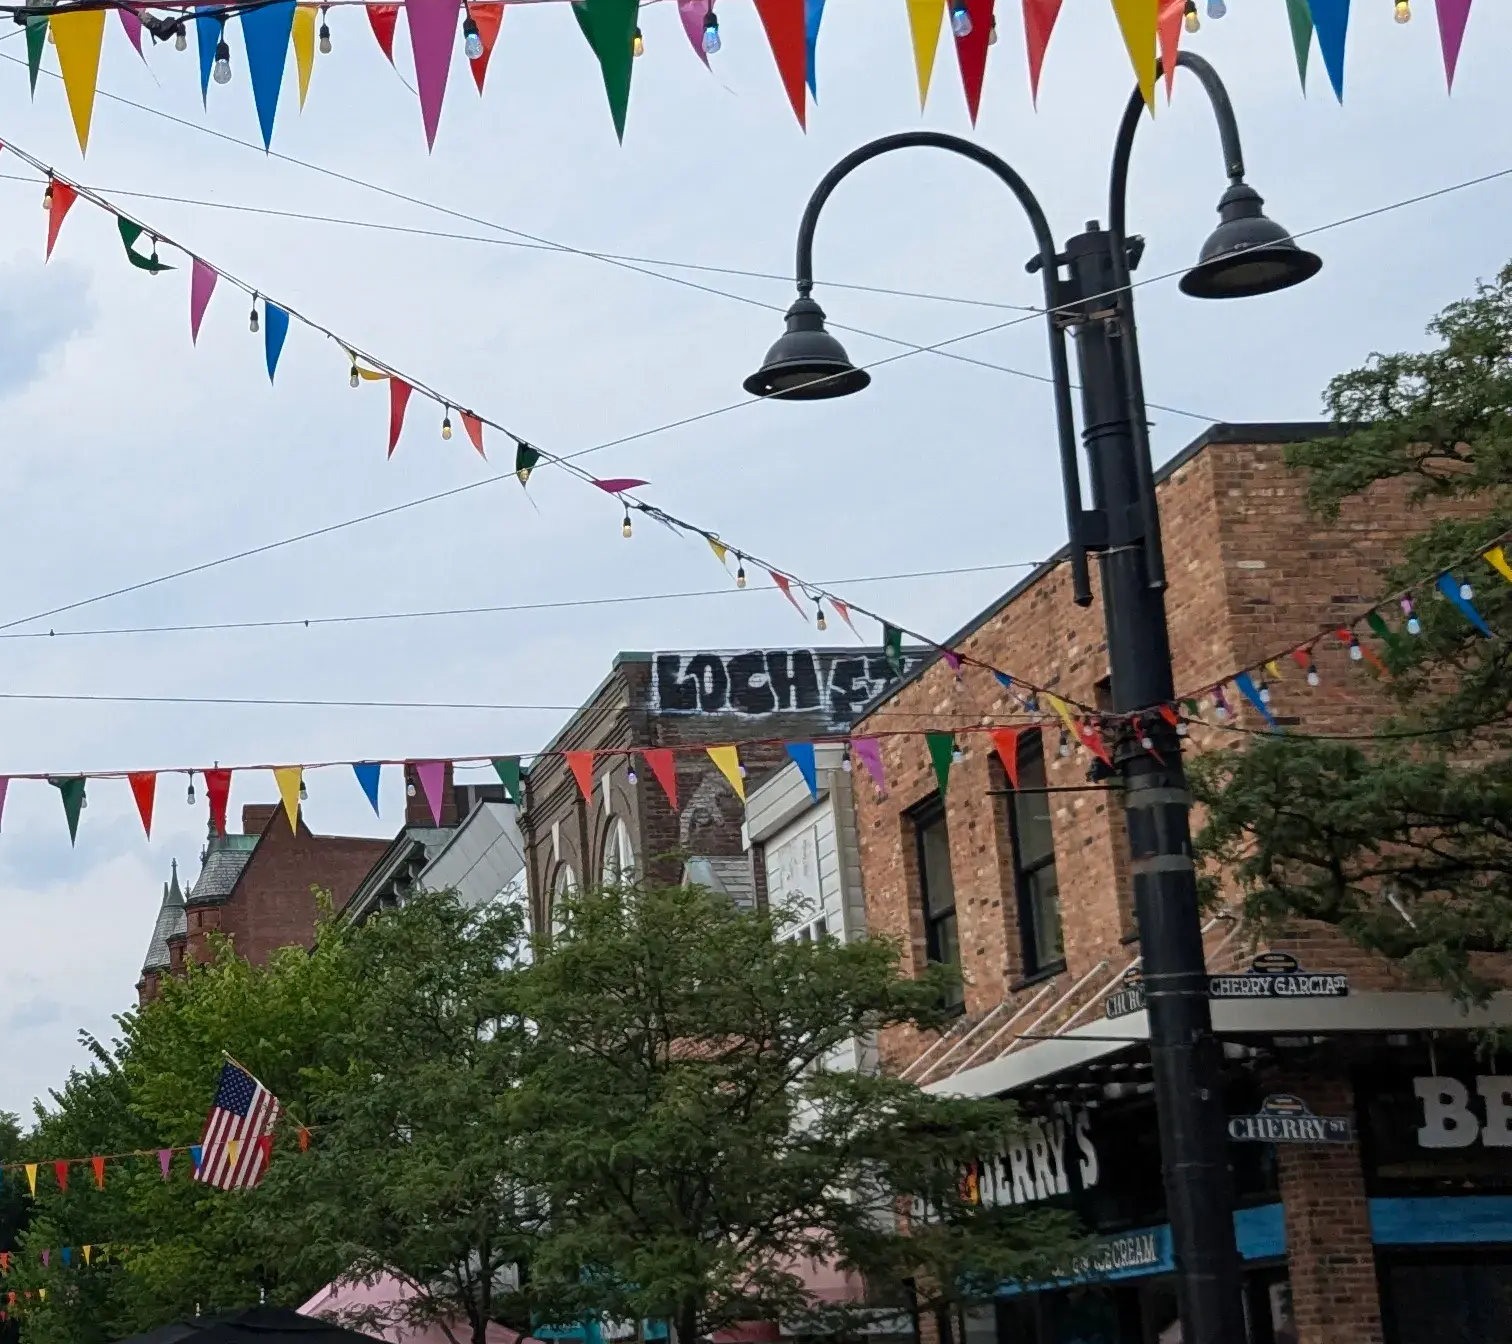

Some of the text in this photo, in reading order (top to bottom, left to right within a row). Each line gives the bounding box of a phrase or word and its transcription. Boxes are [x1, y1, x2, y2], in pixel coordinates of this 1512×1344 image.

[1209, 976, 1272, 996] CHERRY
[1273, 976, 1337, 996] GARCIA
[1106, 989, 1145, 1017] CHURC
[1228, 1117, 1347, 1140] CHERRY ST
[1111, 1233, 1157, 1269] CREAM
